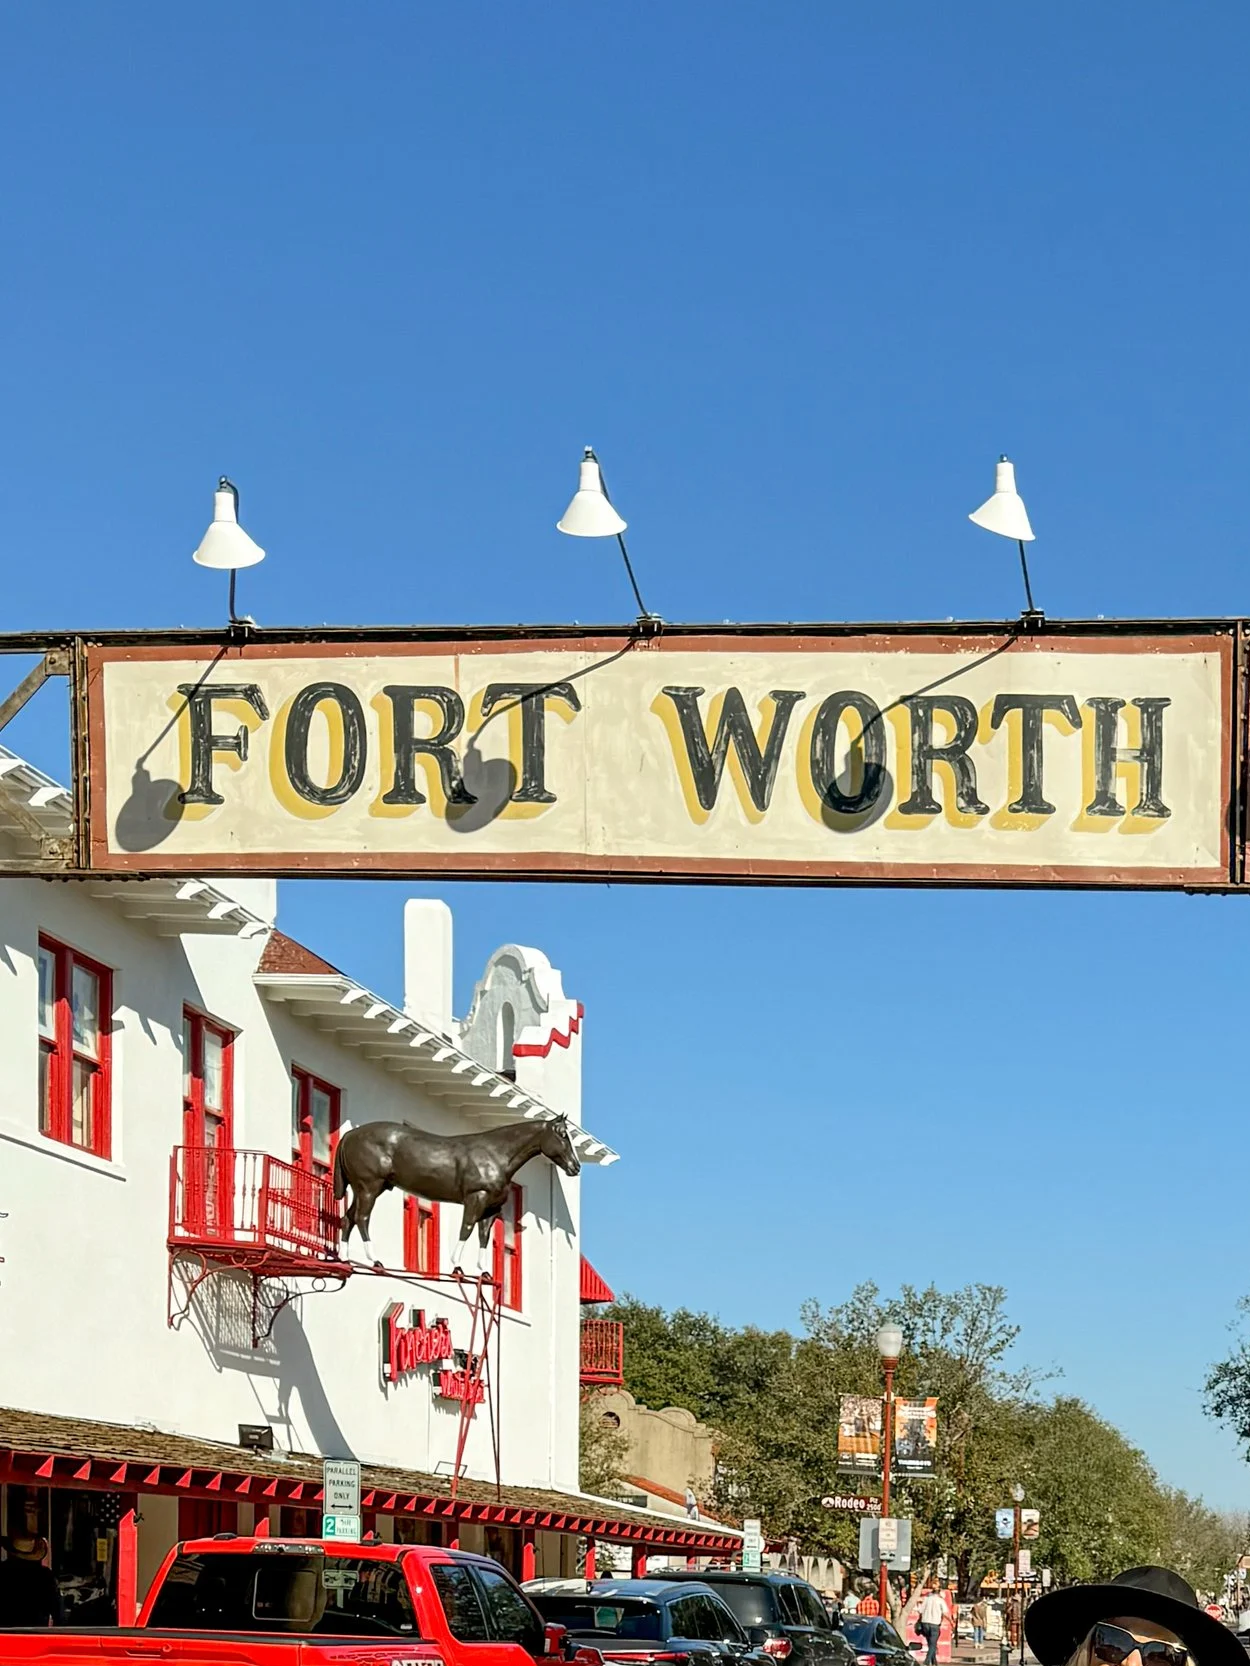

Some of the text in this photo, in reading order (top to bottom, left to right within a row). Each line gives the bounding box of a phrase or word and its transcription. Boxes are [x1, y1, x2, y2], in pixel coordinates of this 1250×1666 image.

[172, 681, 582, 812] FORT
[656, 685, 1172, 824] WORTH
[326, 1466, 357, 1476] PARALLEL
[328, 1479, 356, 1488] PARKING
[333, 1492, 350, 1500] ONLY
[834, 1496, 866, 1509] Rodeo
[326, 1518, 335, 1533] 2
